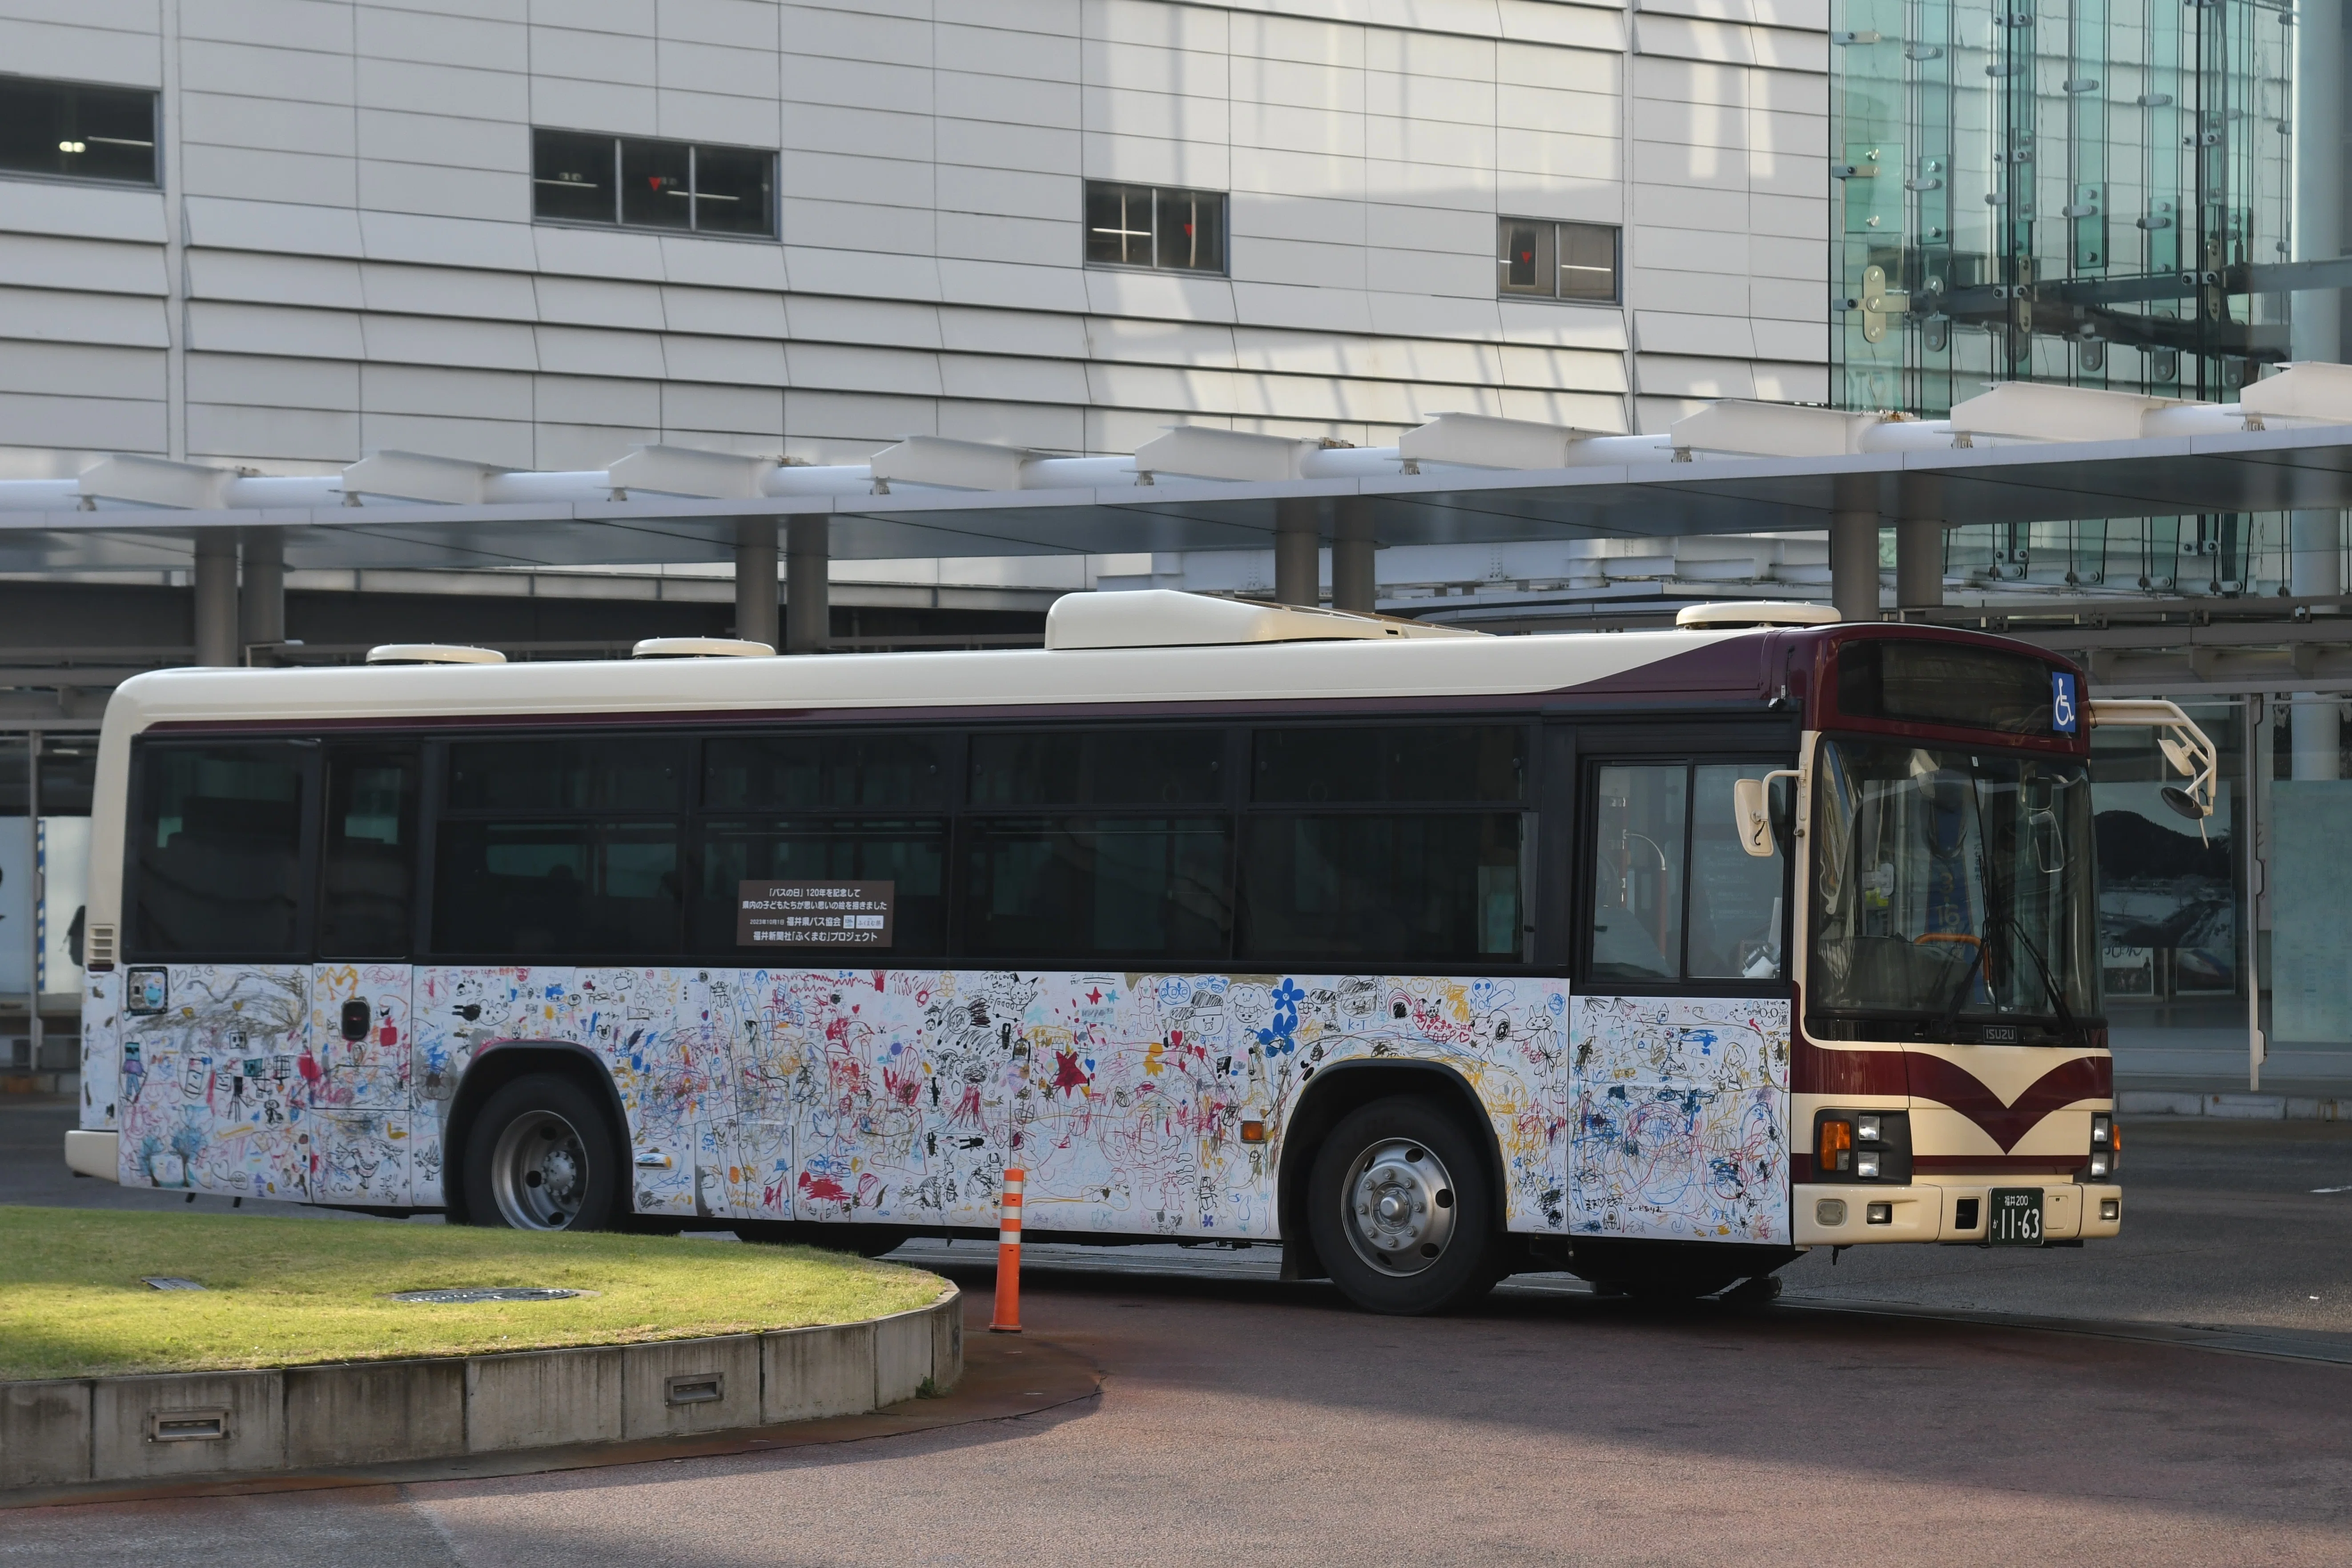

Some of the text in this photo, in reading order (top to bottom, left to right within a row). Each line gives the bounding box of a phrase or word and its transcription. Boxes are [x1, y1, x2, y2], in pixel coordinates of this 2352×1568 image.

[742, 901, 887, 910] 県内の子どもたちが思い思いの絵を描きました
[787, 917, 841, 927] 福井県バス協会
[753, 931, 877, 941] 福井新聞社「ふくまむ」プロジェクト
[1986, 1028, 2014, 1040] ISUZU
[1992, 1219, 1998, 1229] か
